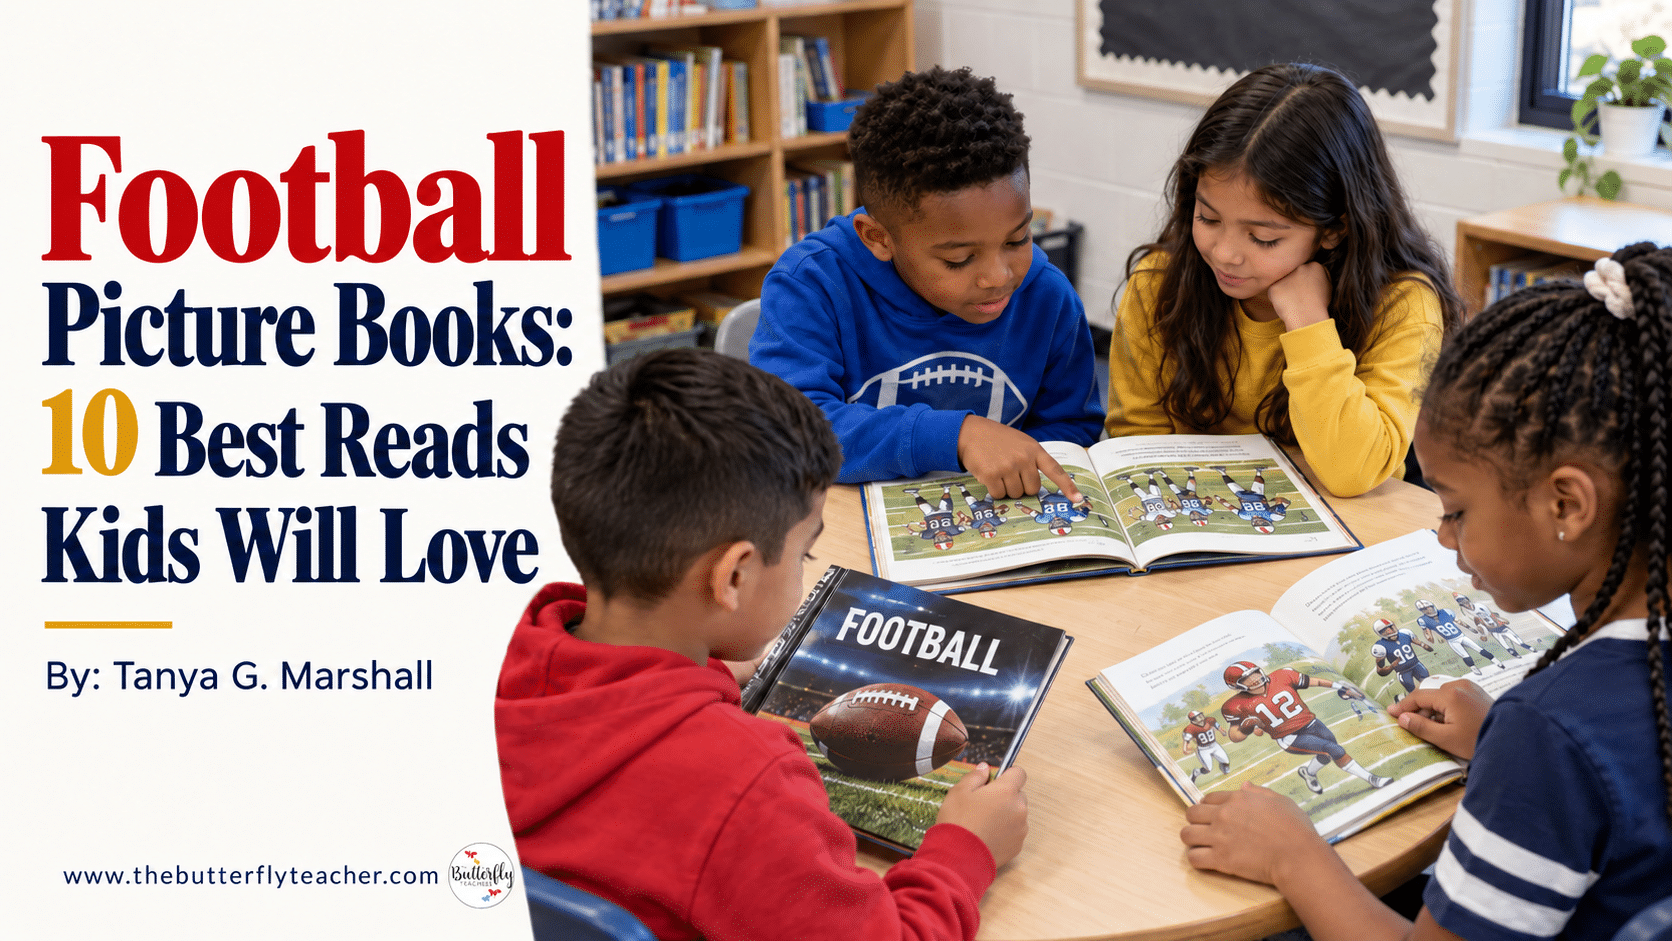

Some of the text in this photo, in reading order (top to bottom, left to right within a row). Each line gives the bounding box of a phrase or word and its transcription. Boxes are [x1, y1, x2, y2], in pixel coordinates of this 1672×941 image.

[836, 606, 1001, 676] FOOTBALL
[1436, 622, 1459, 637] 88
[1255, 690, 1303, 728] 12
